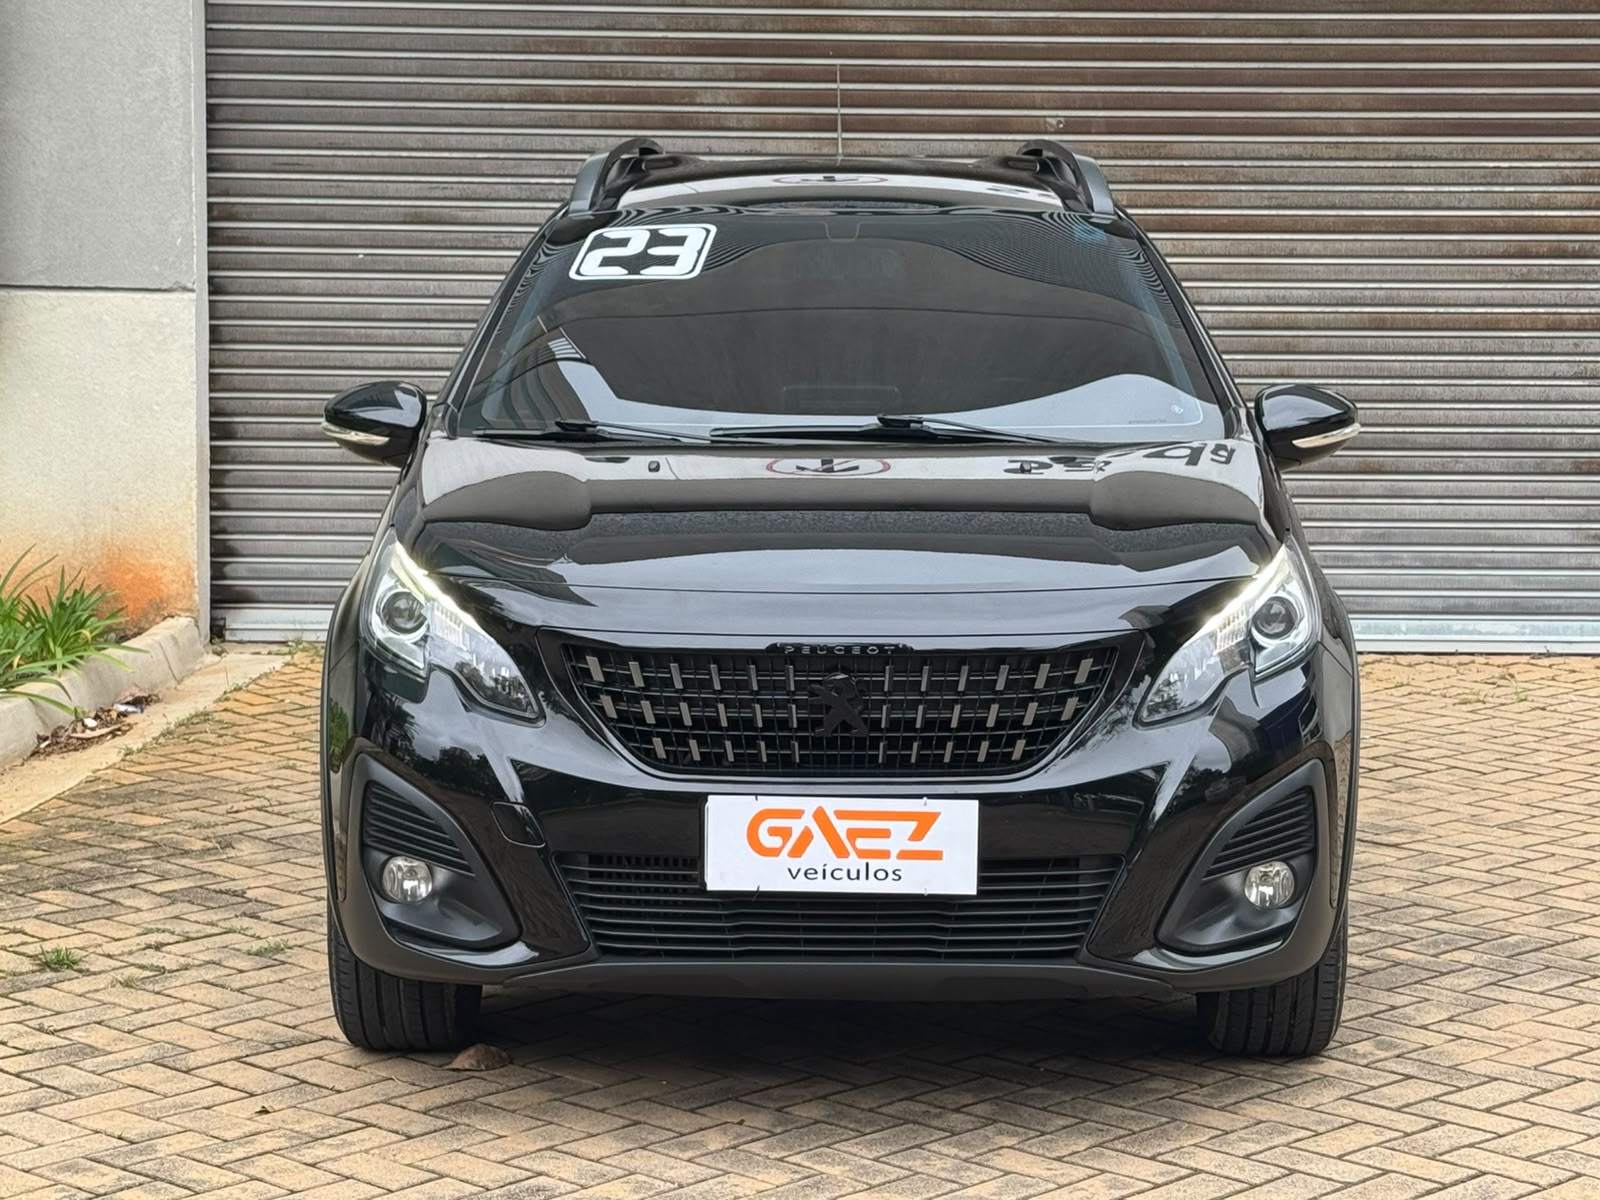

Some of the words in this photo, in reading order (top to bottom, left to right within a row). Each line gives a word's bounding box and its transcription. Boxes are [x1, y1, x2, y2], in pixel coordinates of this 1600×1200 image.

[579, 228, 707, 276] 23
[784, 645, 896, 655] PEUGEOT
[746, 805, 944, 861] GAEZ
[787, 861, 903, 882] veículos
